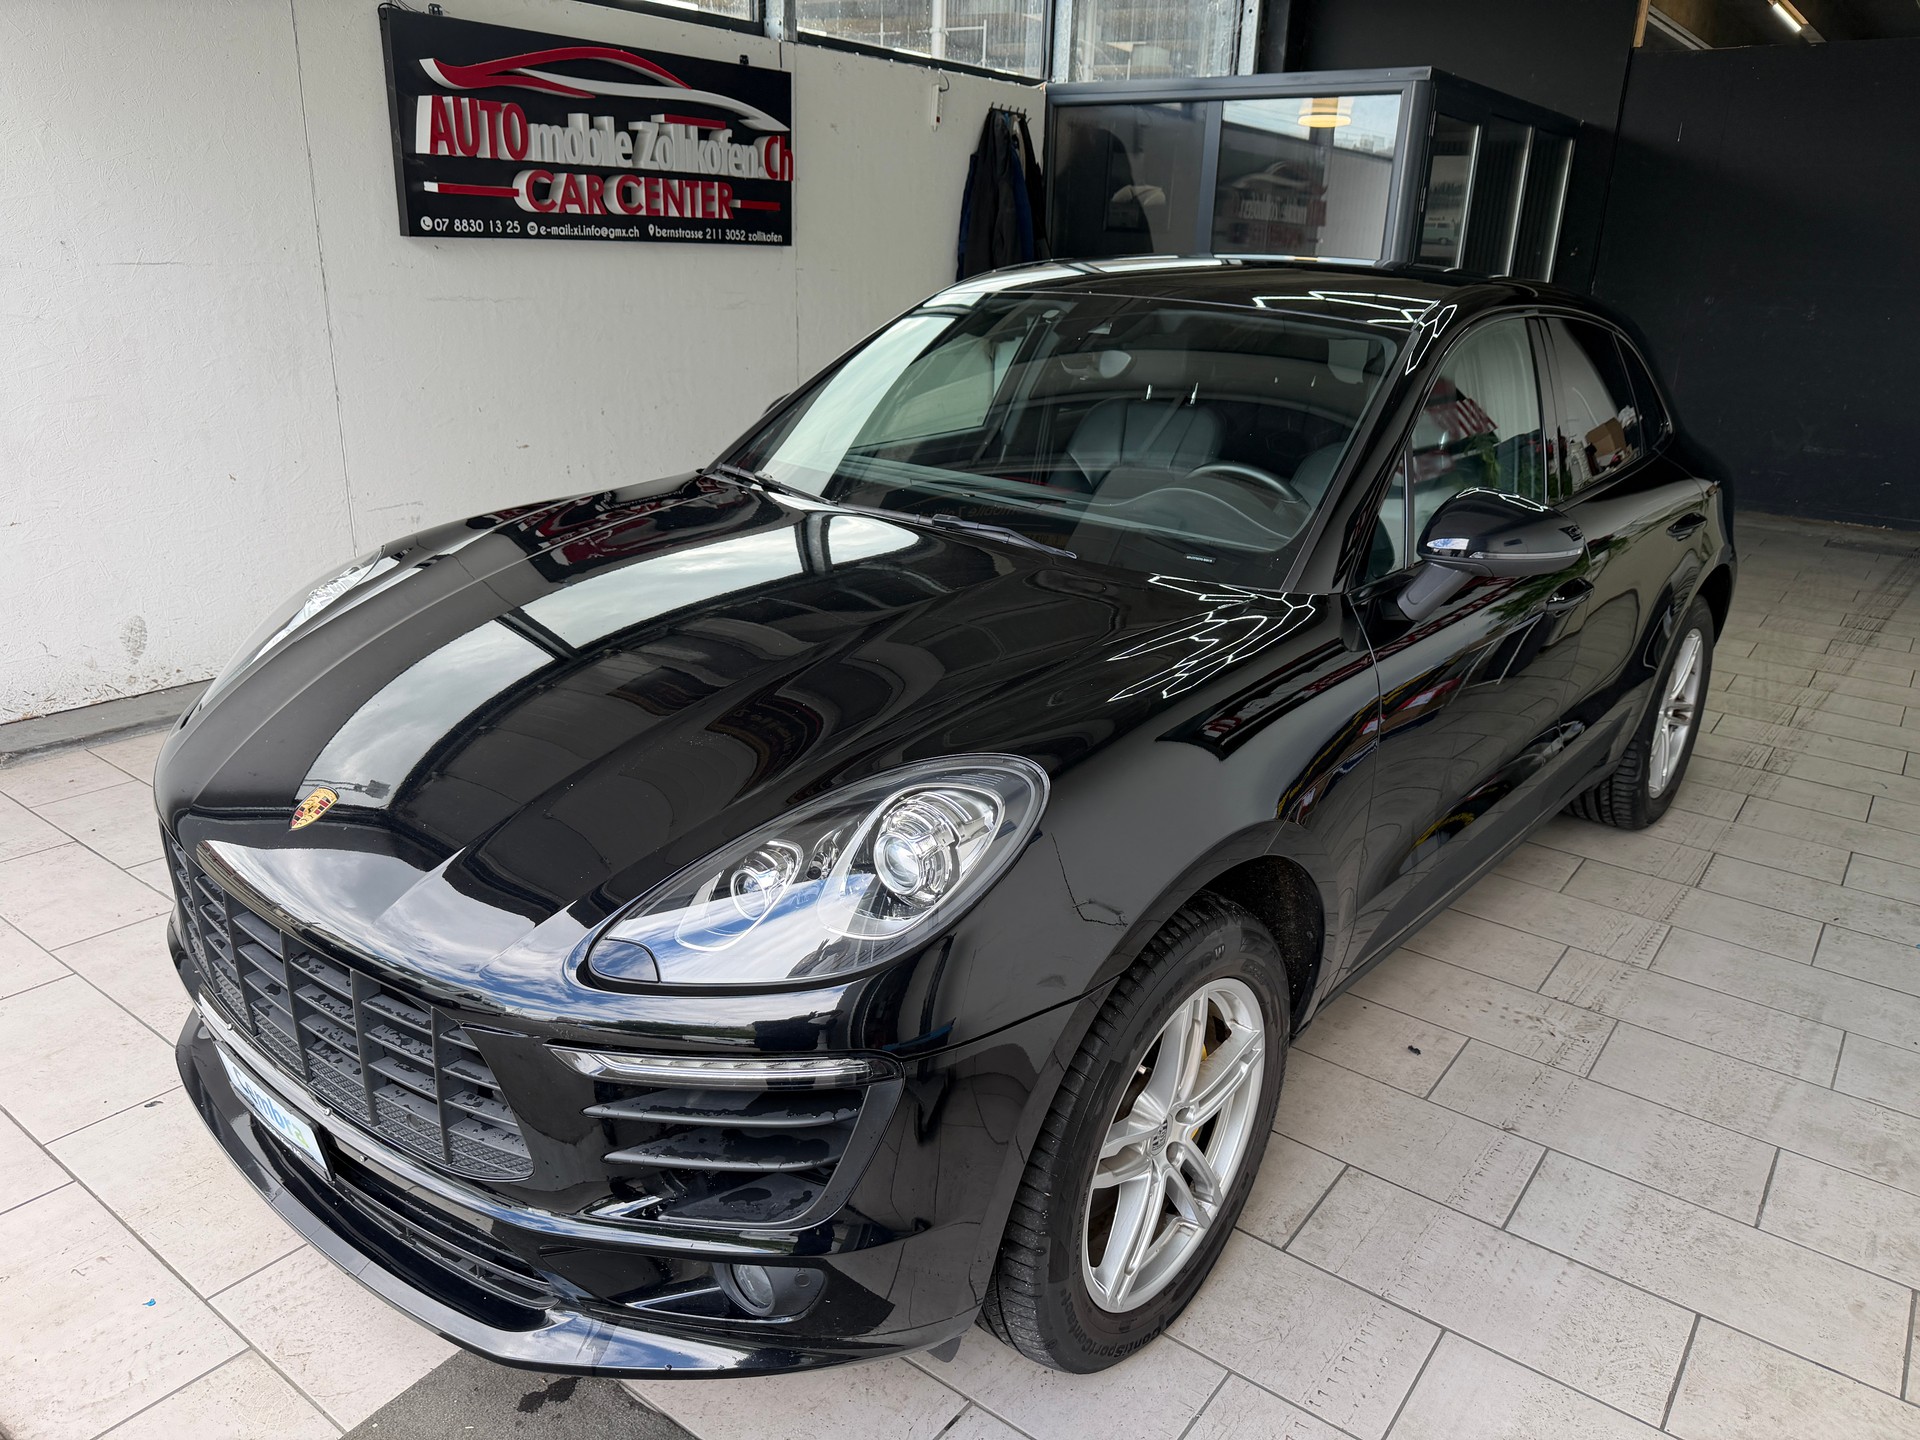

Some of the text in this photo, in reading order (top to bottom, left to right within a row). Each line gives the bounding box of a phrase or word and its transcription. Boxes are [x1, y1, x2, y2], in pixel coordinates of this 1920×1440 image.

[416, 94, 633, 168] AUTOmobile
[513, 169, 734, 219] CAR CENTER
[434, 218, 450, 232] 07
[454, 218, 484, 233] 8830
[489, 219, 503, 233] 13
[506, 220, 521, 234] 25
[655, 225, 704, 240] bernstrasse
[705, 228, 722, 240] 211
[725, 228, 746, 241] 3052
